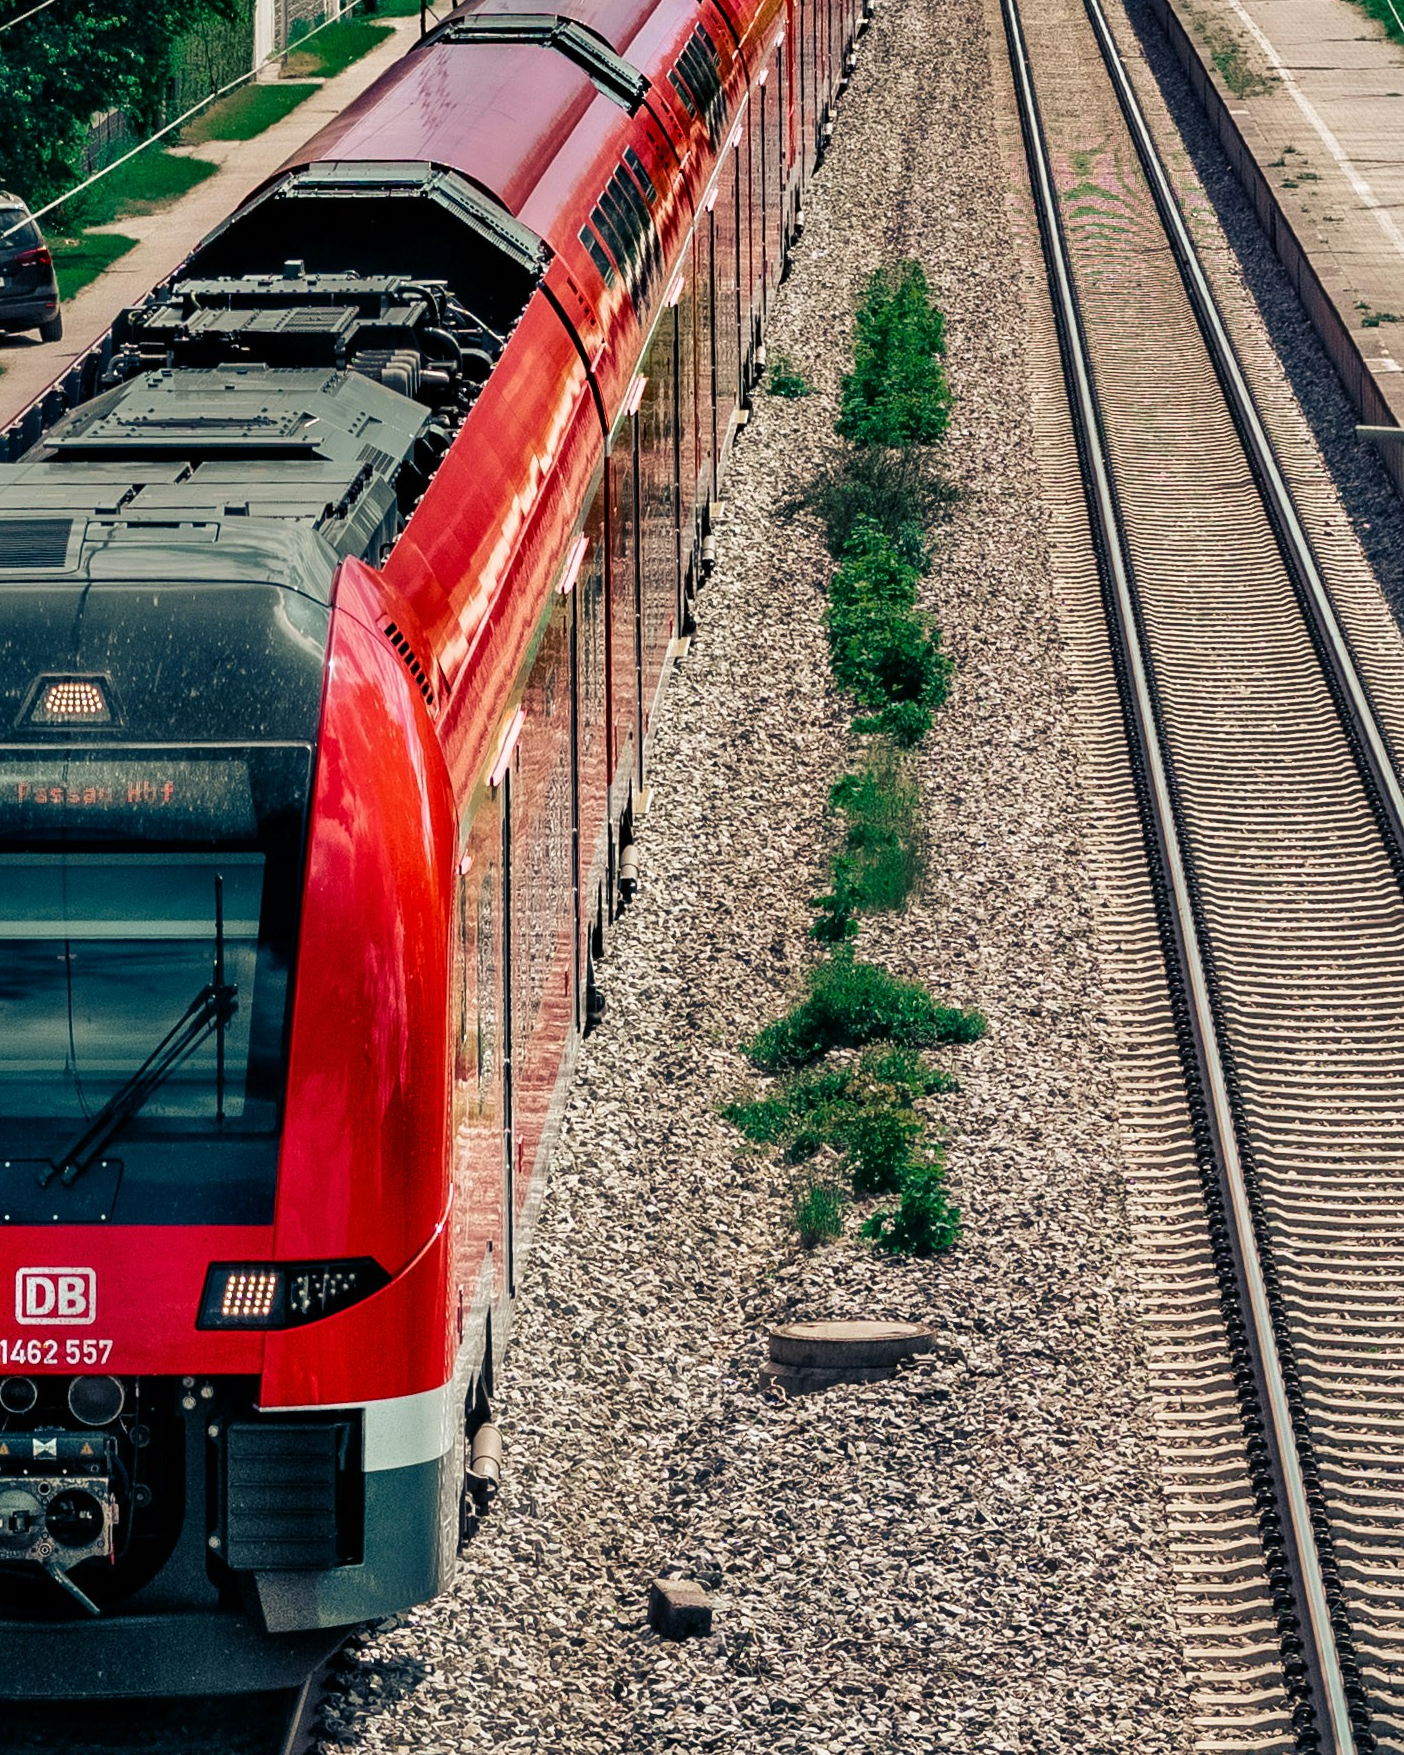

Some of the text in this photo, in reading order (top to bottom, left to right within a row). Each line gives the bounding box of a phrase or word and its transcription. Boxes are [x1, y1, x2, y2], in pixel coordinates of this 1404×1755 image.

[127, 780, 175, 803] Hbf
[26, 1276, 87, 1316] DB
[0, 1339, 114, 1365] 1462 557
